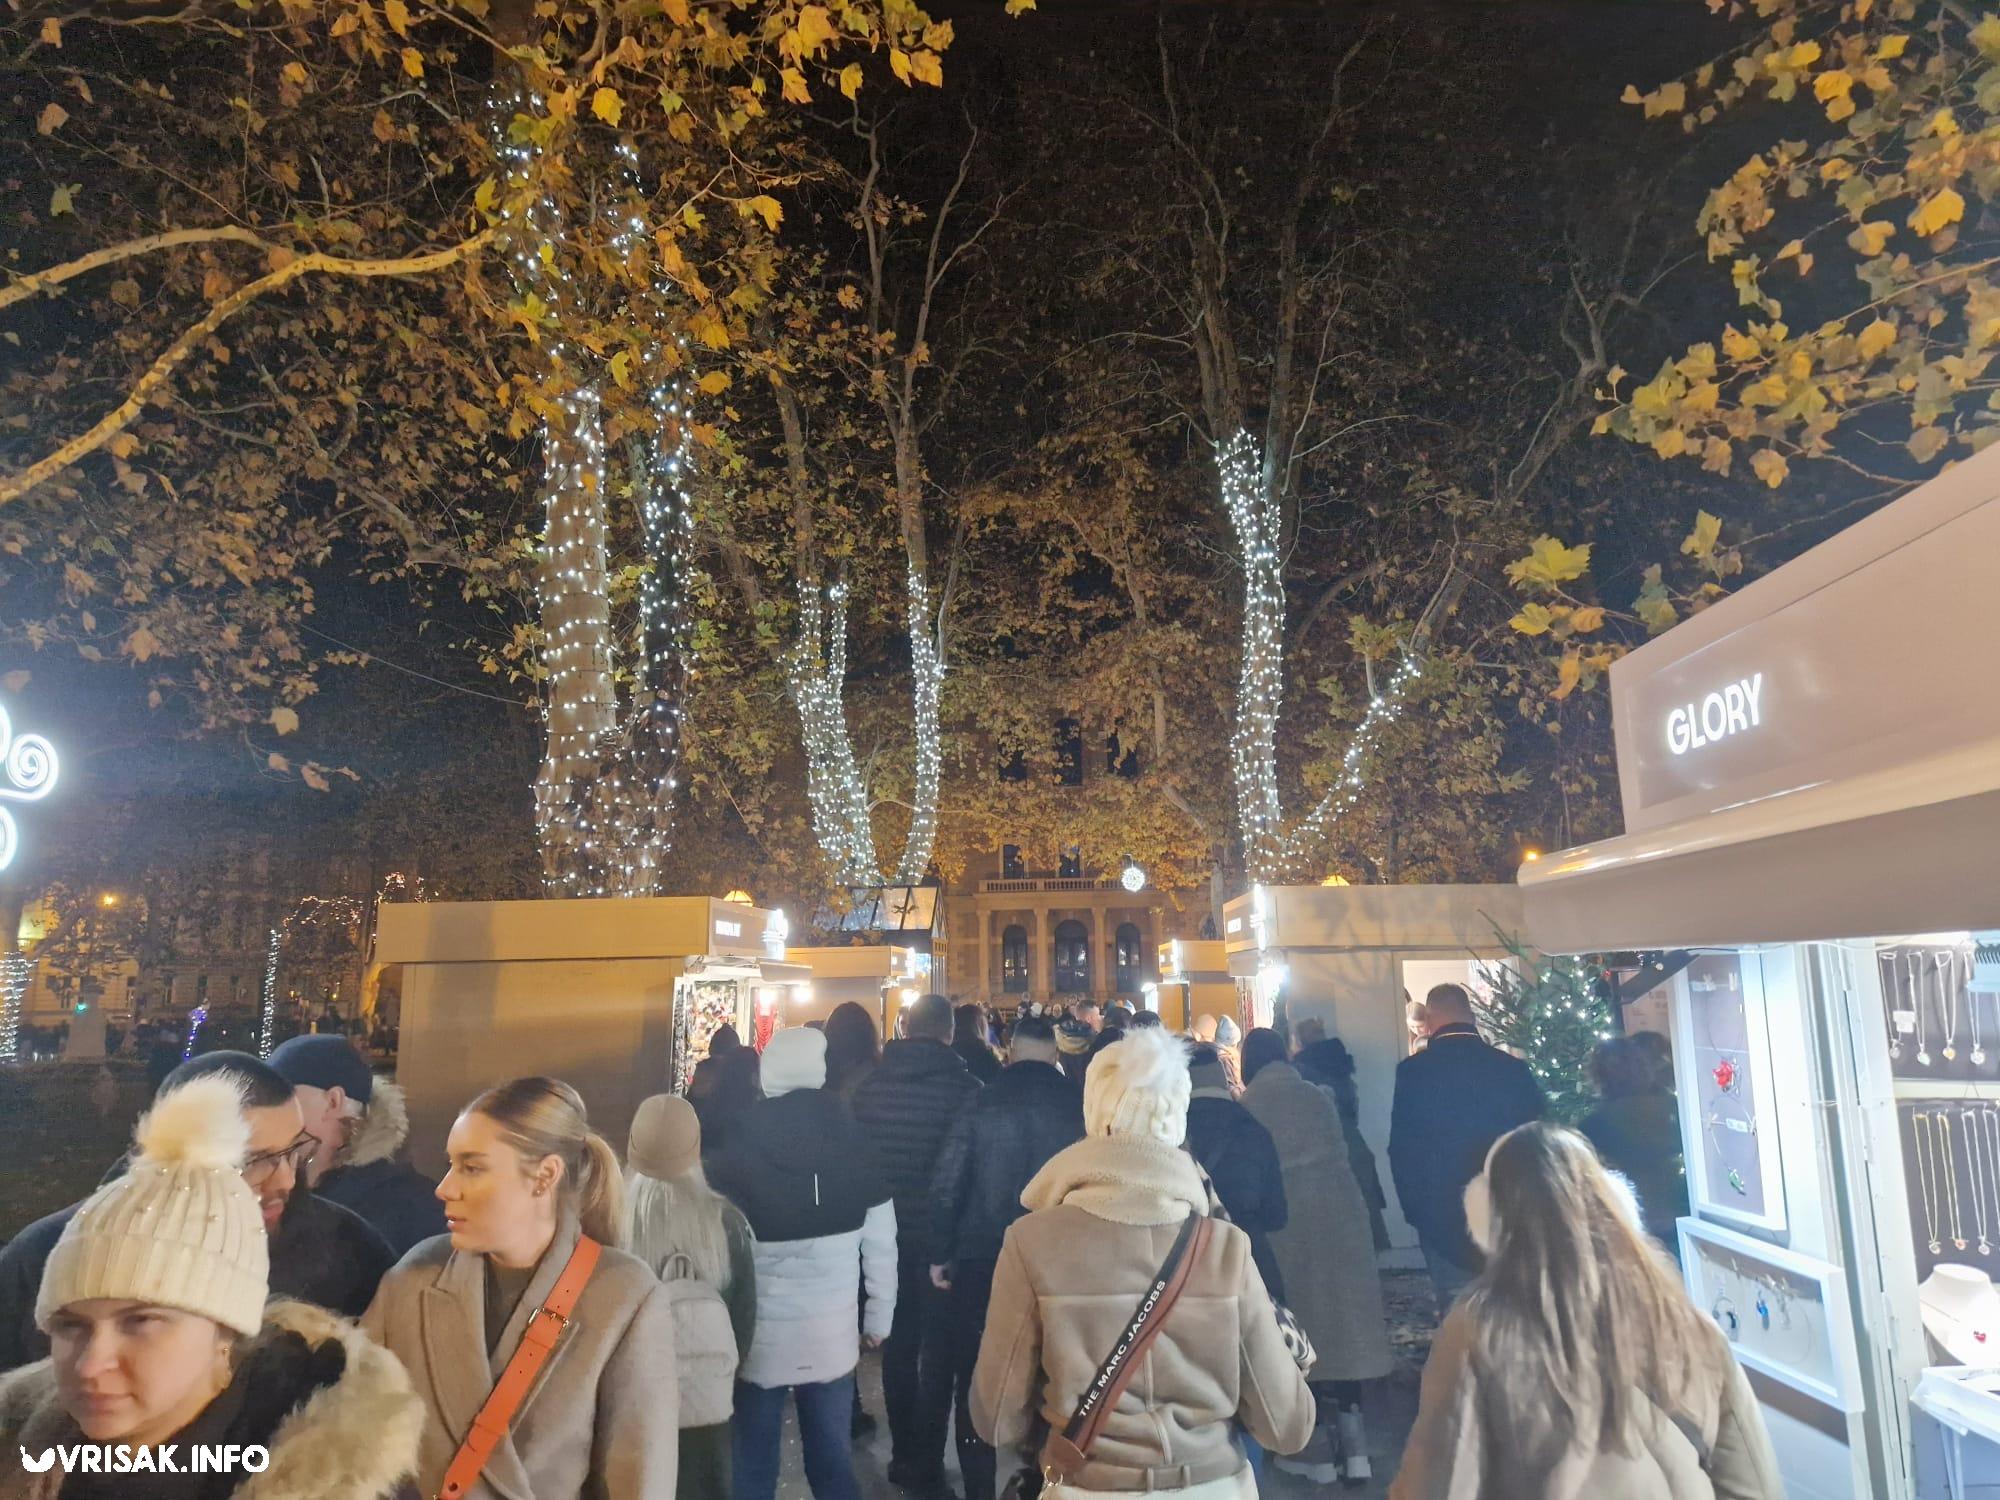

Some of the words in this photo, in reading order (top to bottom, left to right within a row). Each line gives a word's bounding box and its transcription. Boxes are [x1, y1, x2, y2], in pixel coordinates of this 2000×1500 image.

[1667, 672, 1762, 755] GLORY
[1079, 1389, 1099, 1417] THE
[1097, 1344, 1127, 1388] MARC
[1127, 1280, 1166, 1342] JACOBS
